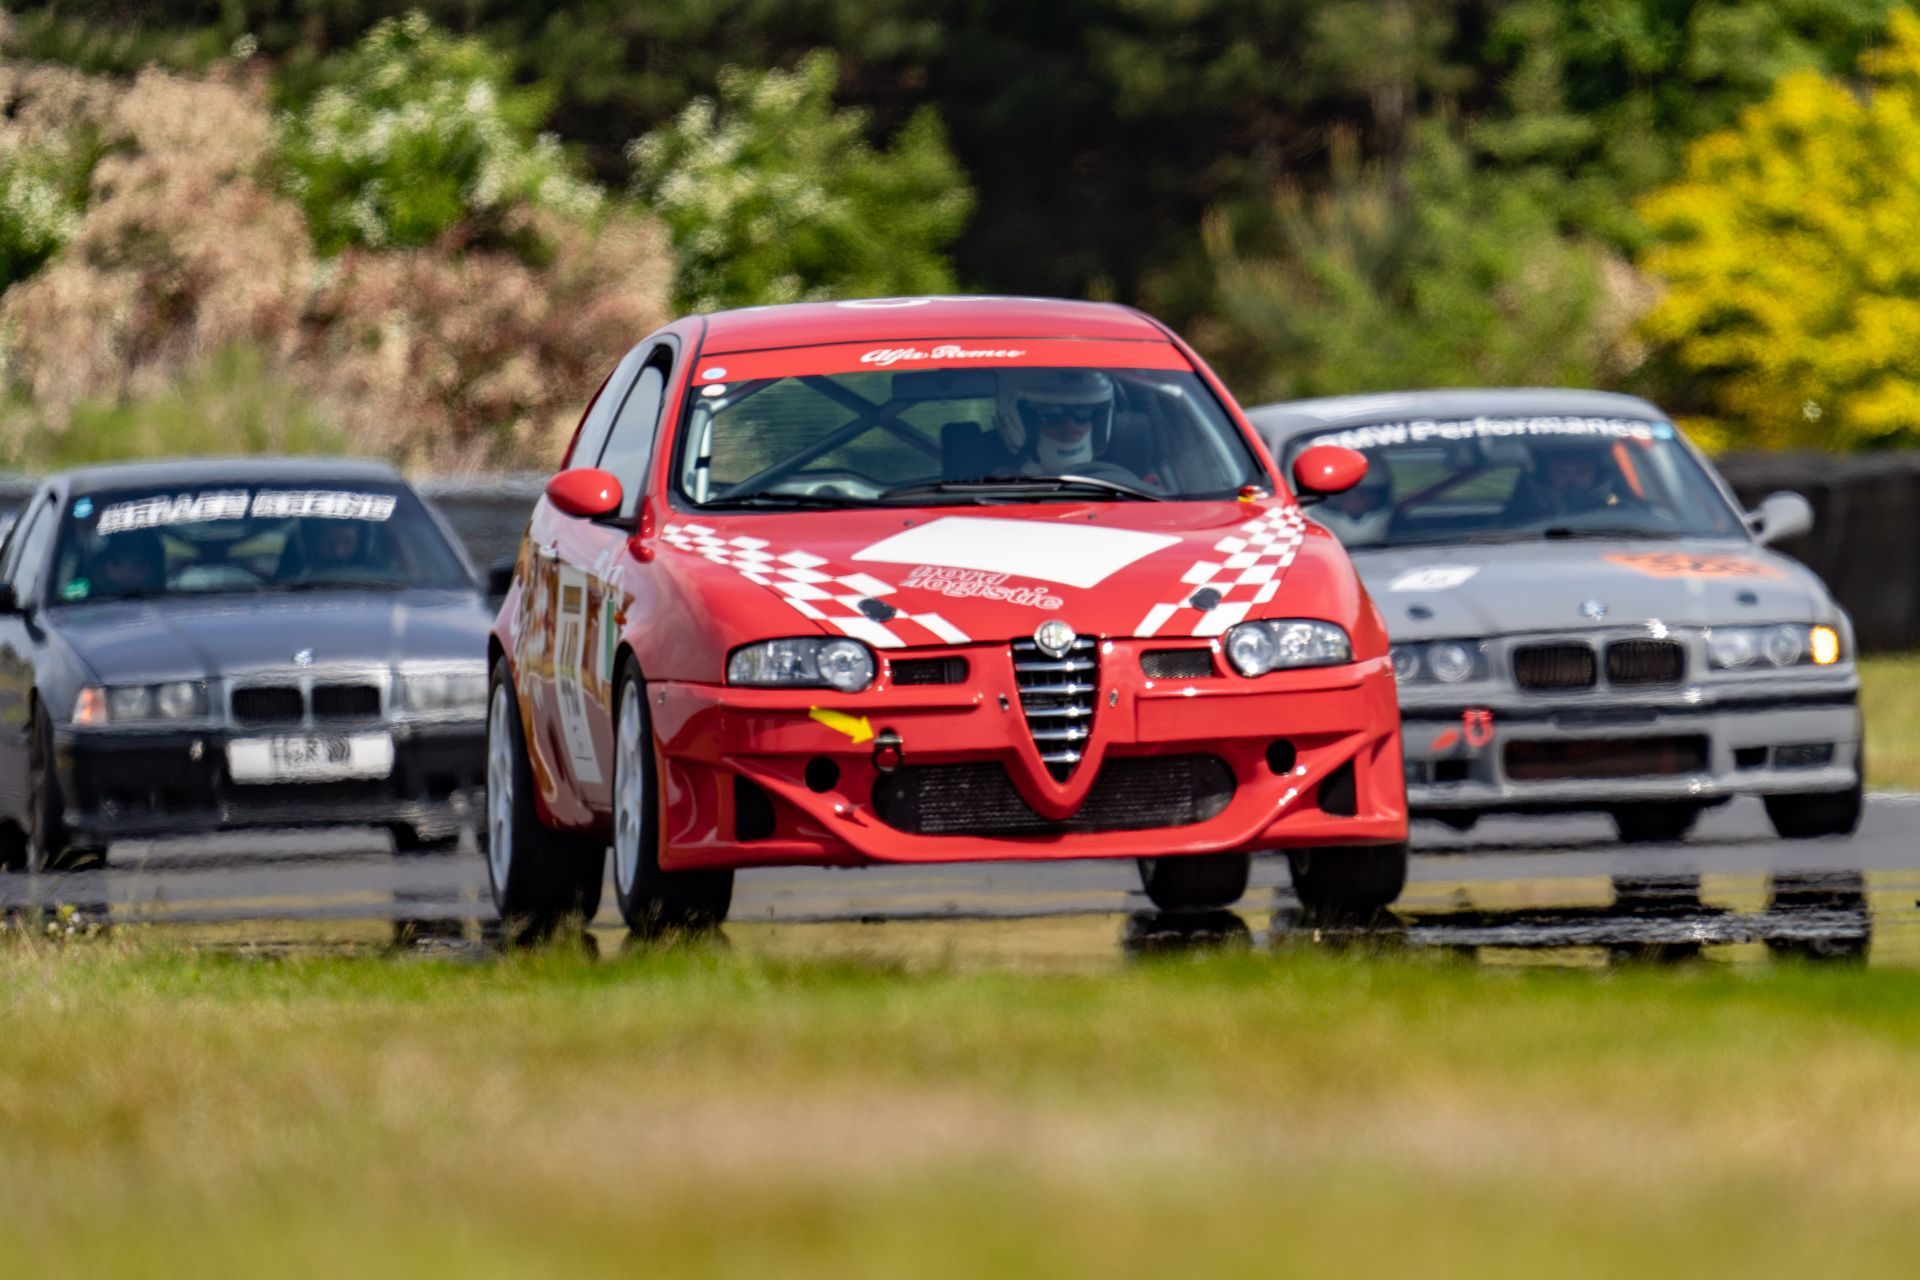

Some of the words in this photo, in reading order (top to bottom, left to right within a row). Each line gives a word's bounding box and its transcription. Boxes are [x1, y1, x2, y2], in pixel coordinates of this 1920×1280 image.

[860, 347, 929, 366] Alfa
[930, 344, 1027, 359] Romeo
[1410, 416, 1654, 441] Performance
[901, 577, 1064, 610] logistic
